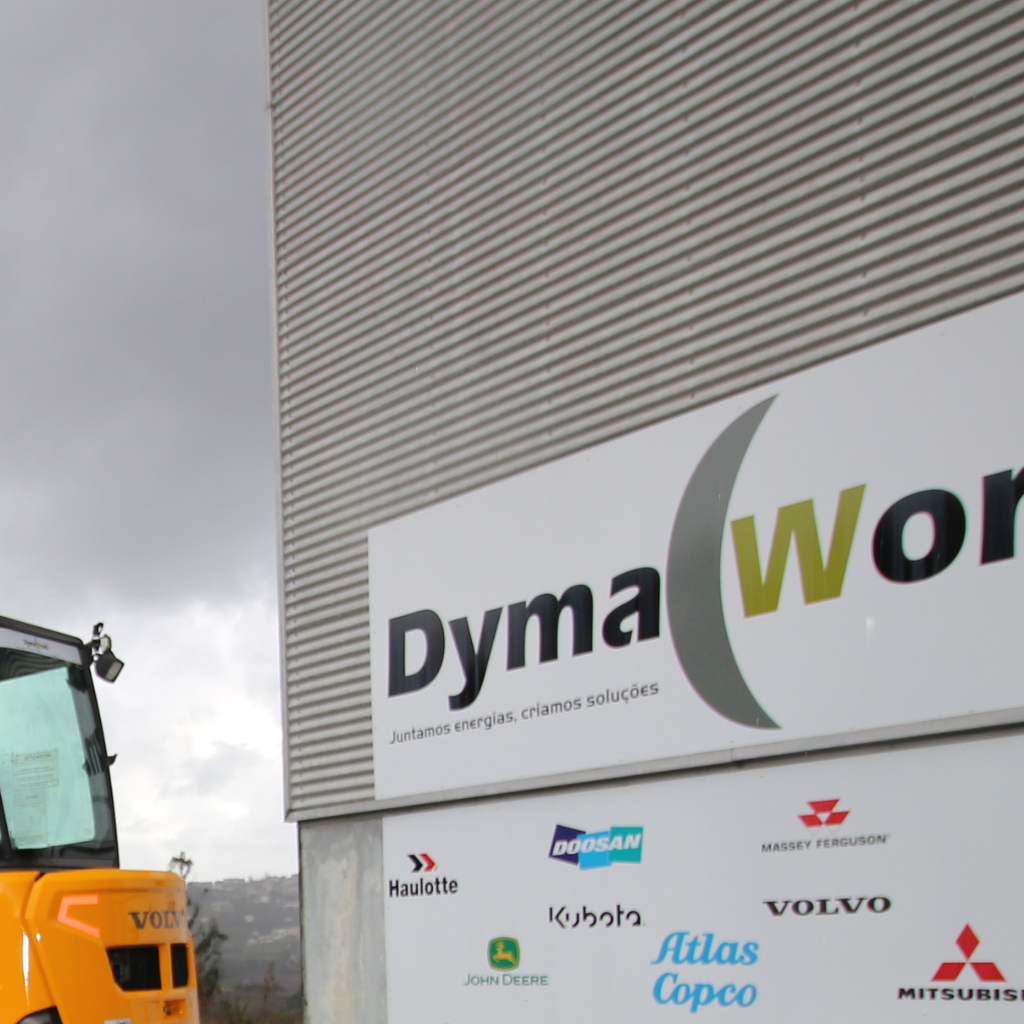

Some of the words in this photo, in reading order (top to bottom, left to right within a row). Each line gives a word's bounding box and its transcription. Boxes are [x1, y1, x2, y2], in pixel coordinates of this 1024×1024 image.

[388, 566, 660, 711] Dyma
[389, 723, 451, 744] Juntamos
[454, 709, 517, 731] energias,
[521, 697, 582, 720] criamos
[586, 682, 659, 707] soluções
[552, 834, 641, 856] DOOSAN
[761, 840, 811, 853] MASSEY
[816, 834, 887, 849] FERGUSON
[389, 877, 458, 897] Haulotte
[548, 904, 641, 928] Kubota
[763, 896, 892, 916] VOLVO
[650, 931, 759, 965] Atlas
[652, 972, 758, 1013] Copco
[897, 988, 1024, 1001] MITSUBIS
